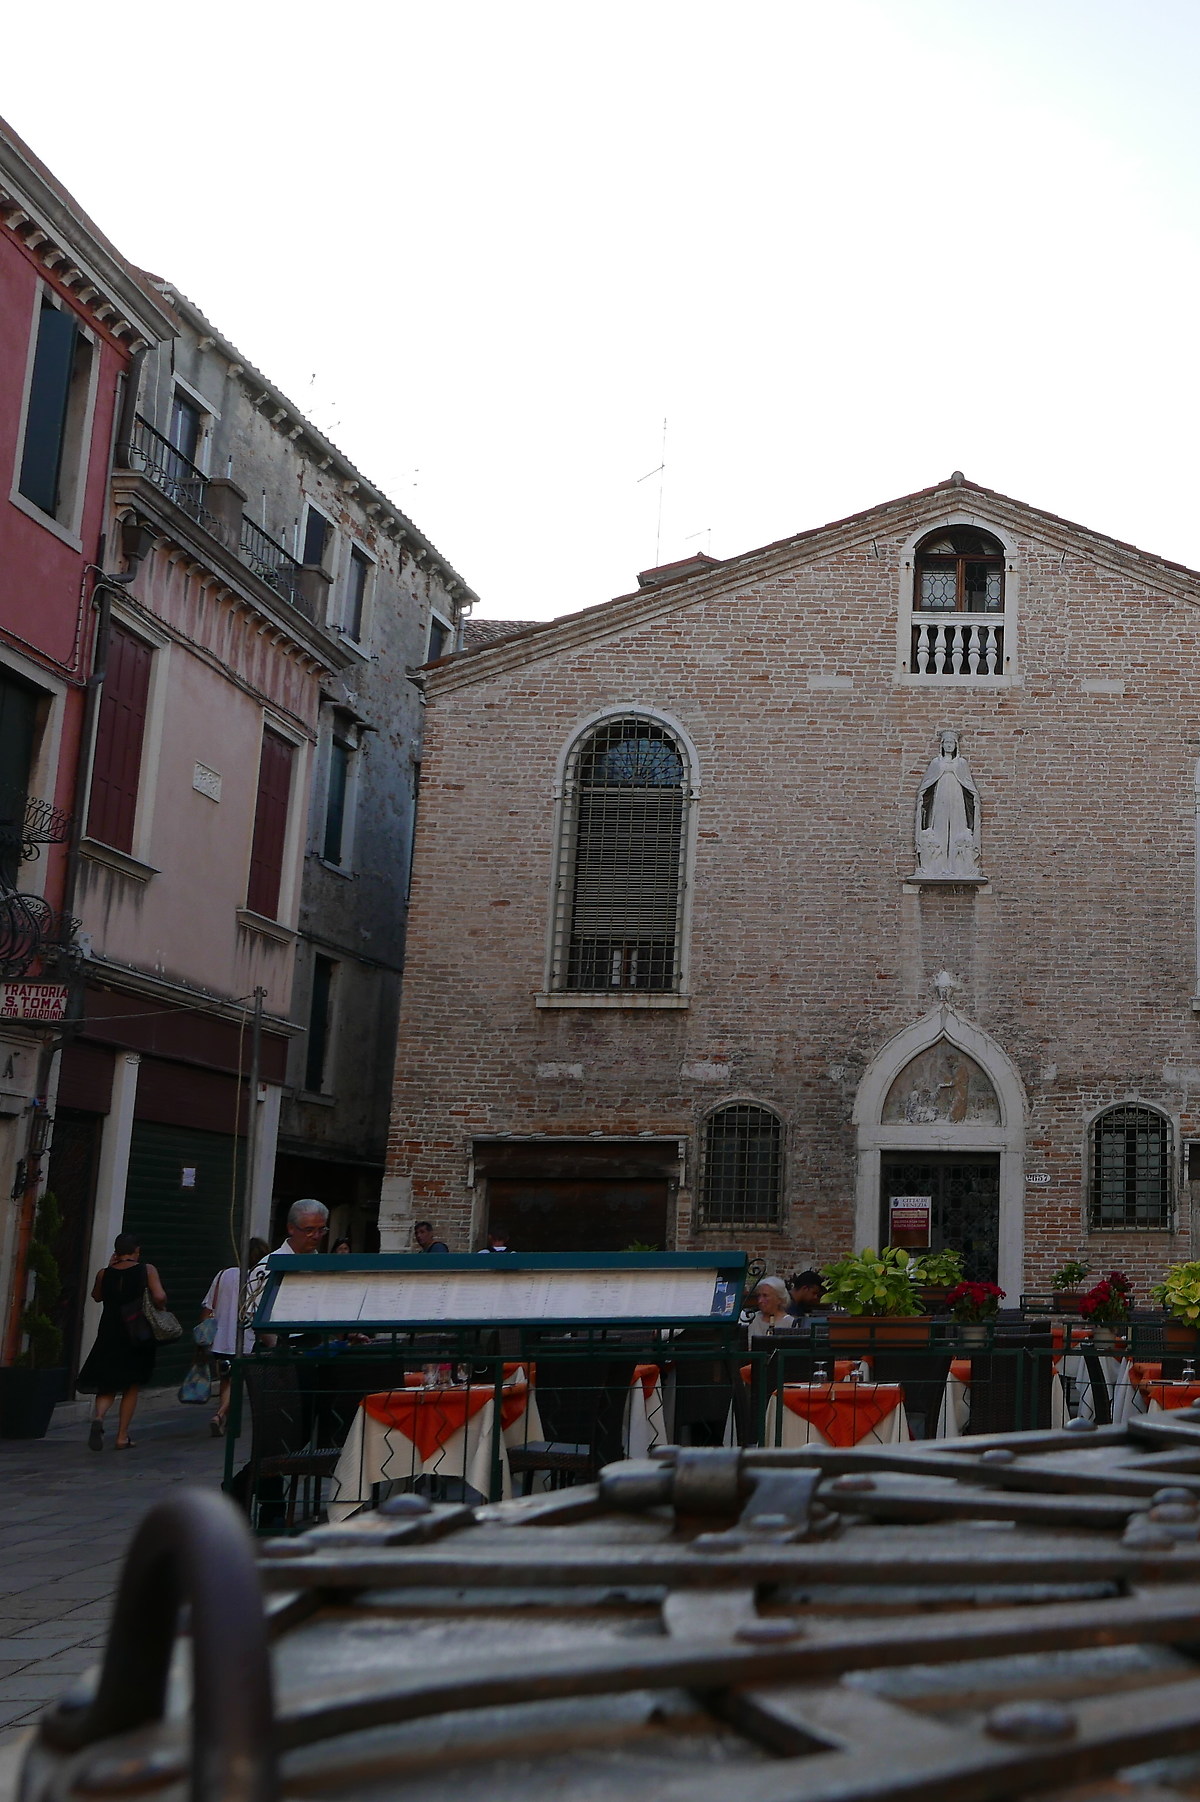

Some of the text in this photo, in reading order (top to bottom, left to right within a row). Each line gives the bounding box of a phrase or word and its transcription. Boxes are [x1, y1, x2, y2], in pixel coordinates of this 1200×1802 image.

[4, 984, 69, 998] TRATTORIA
[5, 996, 18, 1008] S.
[1, 1007, 65, 1020] CON GIARDINO
